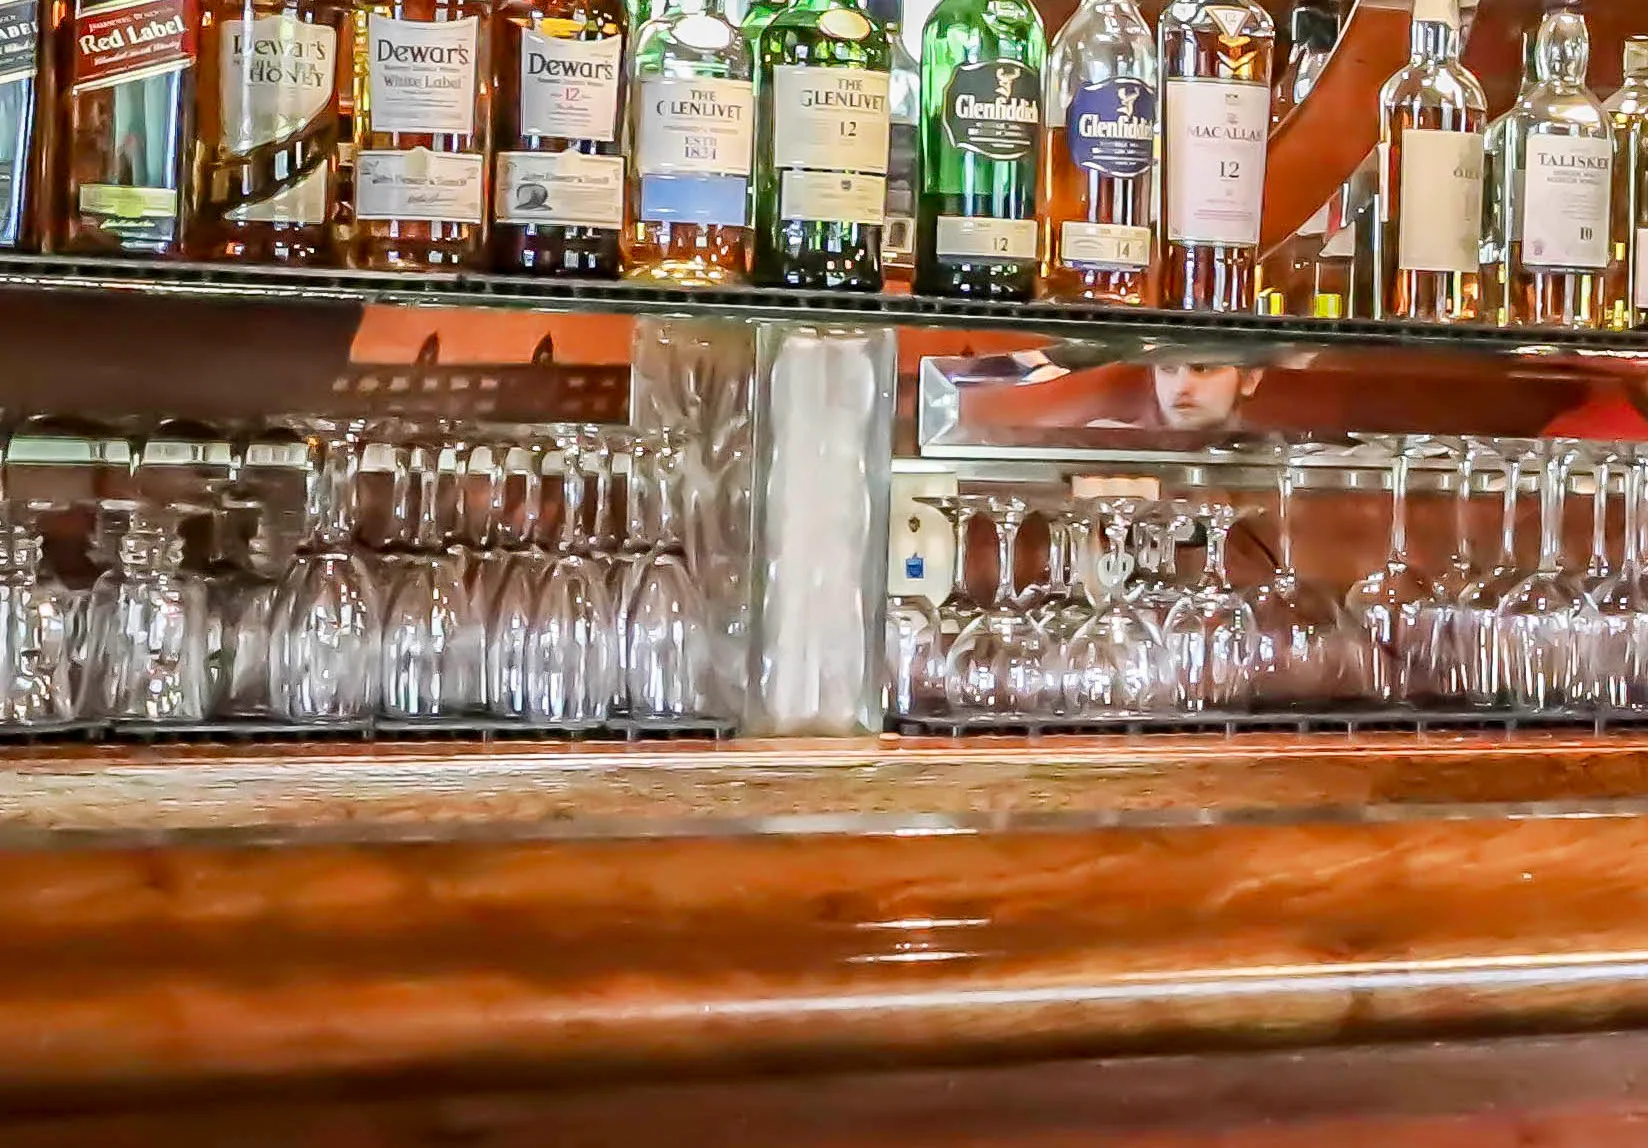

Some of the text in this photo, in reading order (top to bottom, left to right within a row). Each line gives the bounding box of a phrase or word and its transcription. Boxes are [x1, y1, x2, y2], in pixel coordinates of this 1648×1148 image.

[79, 29, 125, 55] Red
[126, 15, 184, 44] Label
[377, 38, 470, 65] Dewar's
[527, 52, 614, 80] Dewar's
[249, 67, 324, 87] HONEY
[424, 75, 461, 89] Label
[837, 79, 863, 91] THE
[565, 87, 580, 102] 12
[690, 89, 717, 101] THE
[801, 90, 886, 112] GLENLIVET
[840, 121, 857, 137] 12
[1219, 161, 1240, 178] 12
[992, 237, 1009, 252] 12
